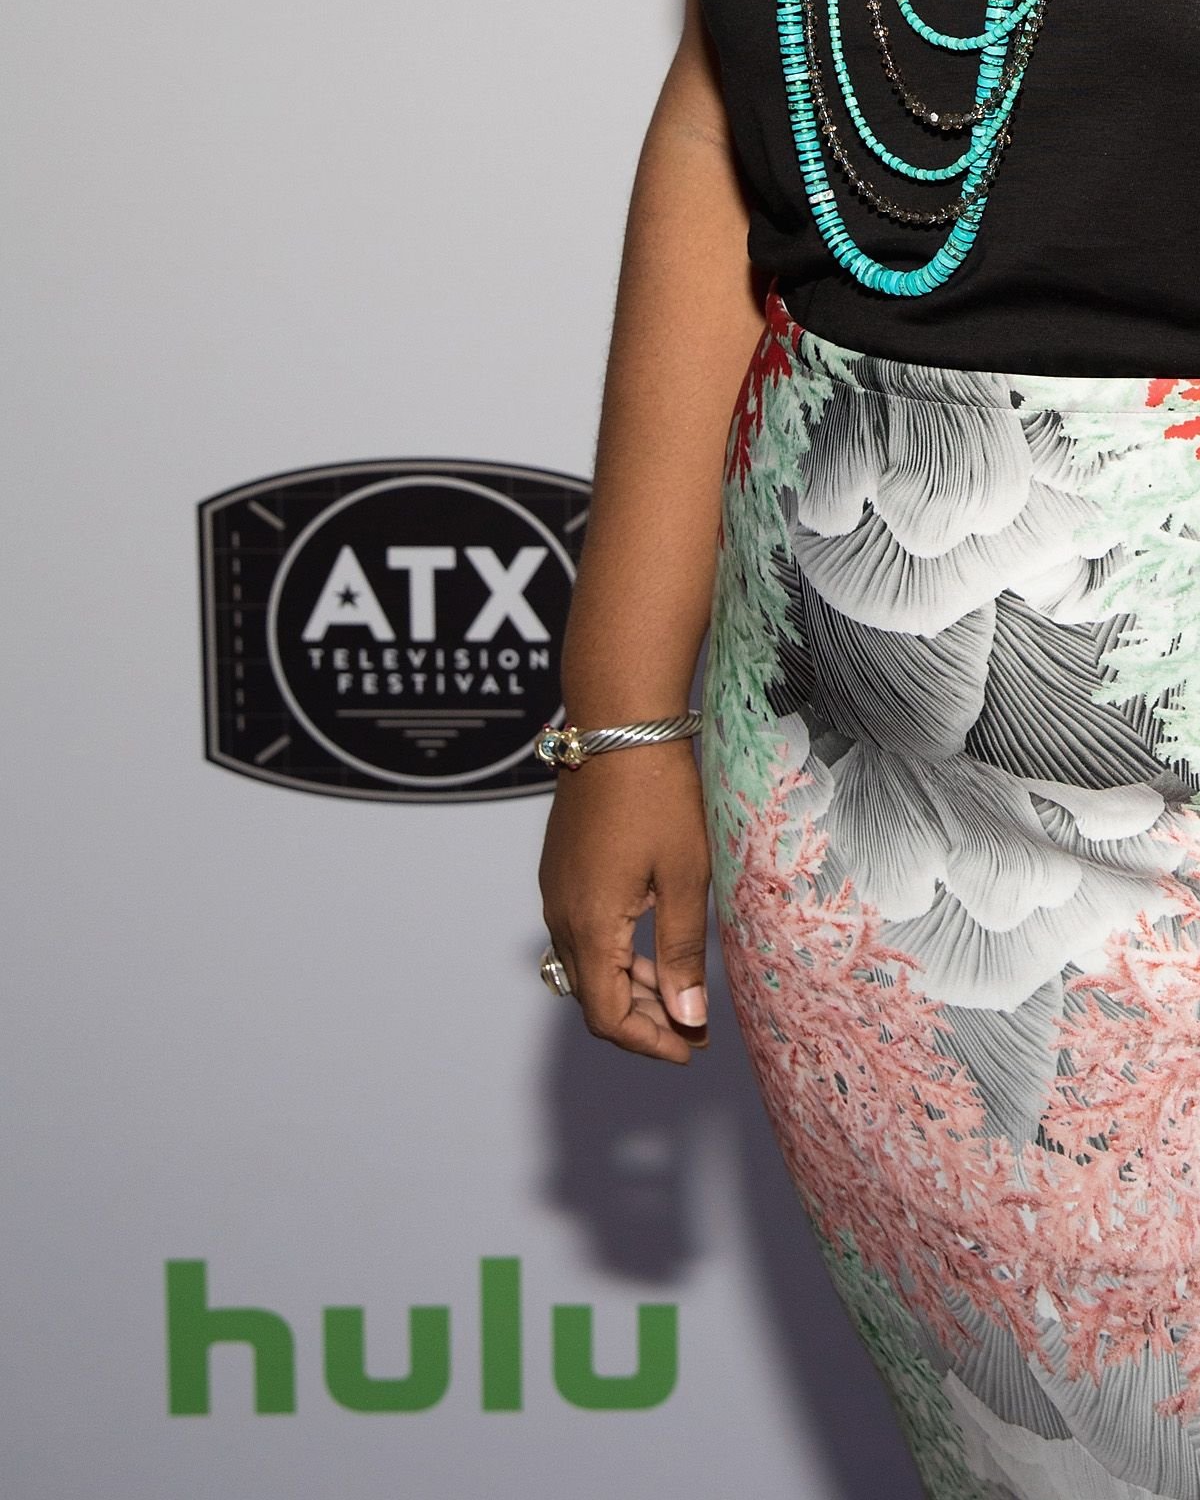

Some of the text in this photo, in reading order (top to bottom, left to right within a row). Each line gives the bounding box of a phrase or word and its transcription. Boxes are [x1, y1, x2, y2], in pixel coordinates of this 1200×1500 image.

[301, 544, 552, 642] ATX
[307, 648, 550, 671] TELEVISION
[336, 673, 525, 695] FESTIVAL
[165, 1257, 678, 1417] hulu
